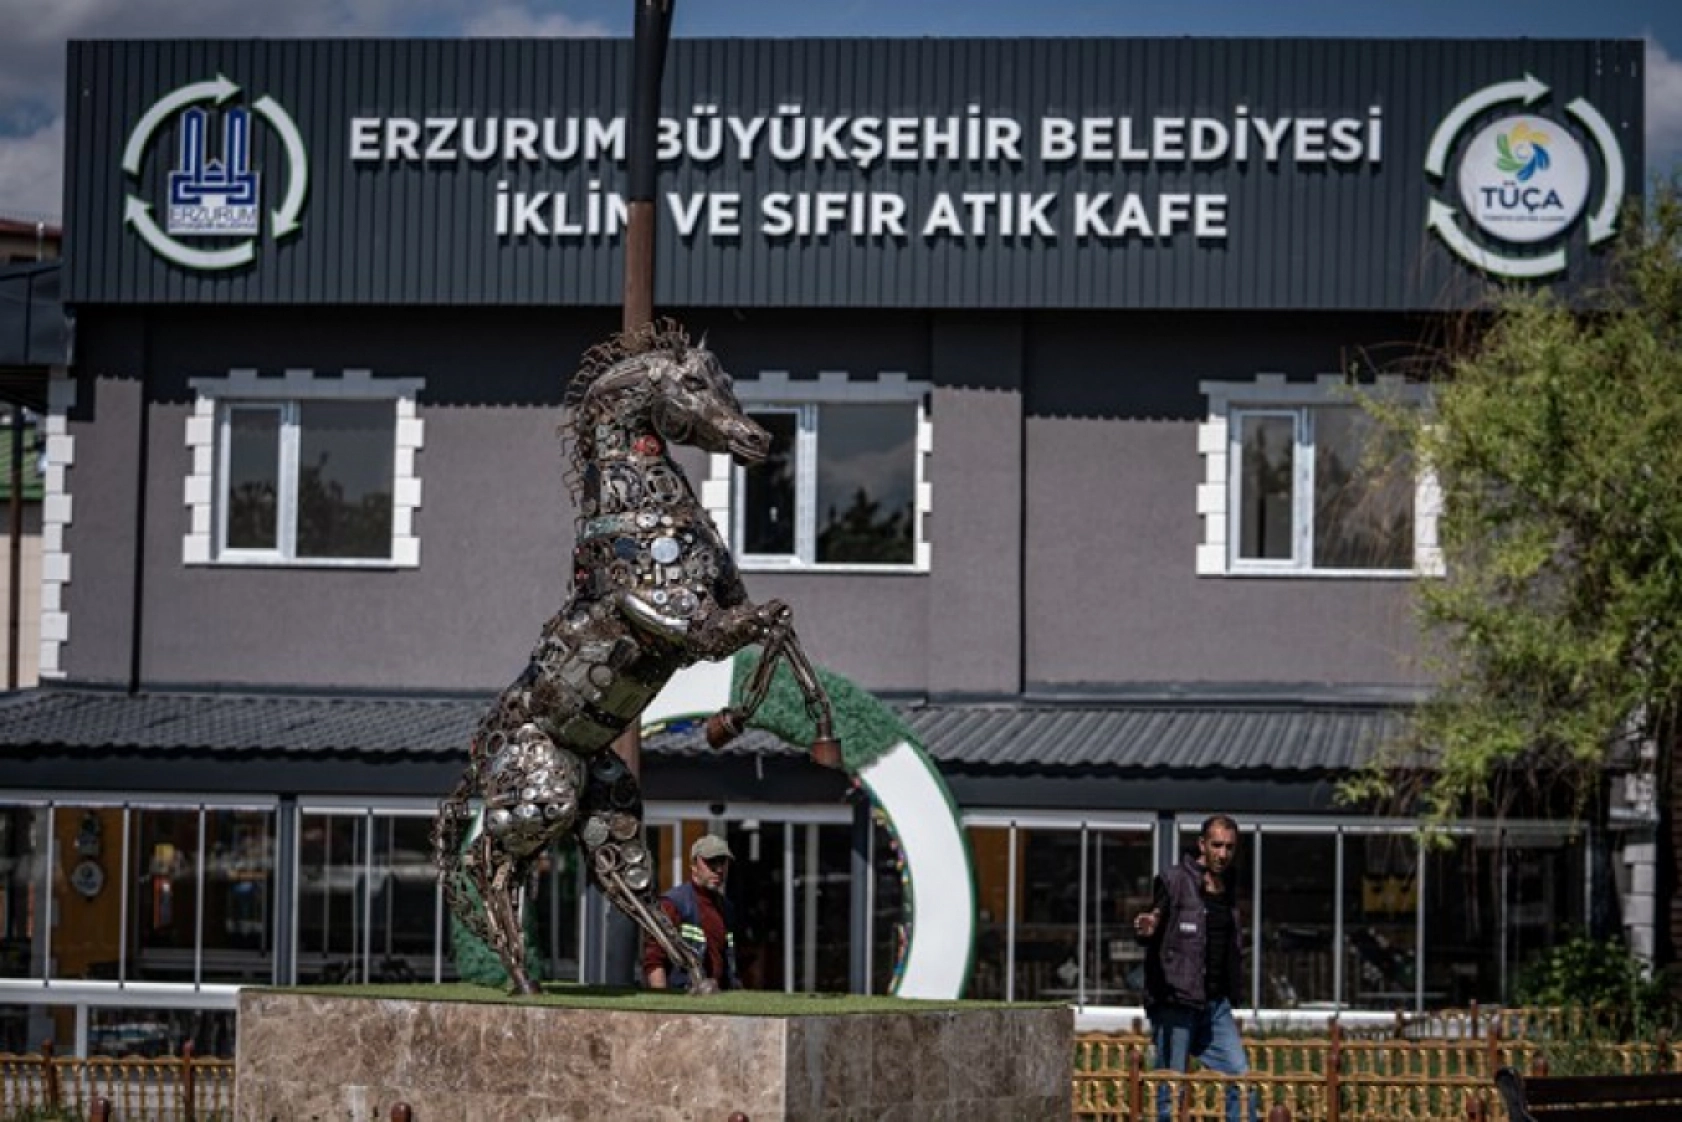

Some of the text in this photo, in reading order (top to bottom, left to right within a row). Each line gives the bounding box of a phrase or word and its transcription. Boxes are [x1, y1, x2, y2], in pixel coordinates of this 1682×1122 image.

[349, 103, 1383, 168] ERZURUM BÜYÜKŞEHİR BELEDİYESİ
[666, 191, 742, 236] VE
[760, 191, 907, 236] SIFIR
[922, 191, 1057, 237] ATIK
[1073, 191, 1228, 238] KAFE
[1480, 180, 1564, 214] TÜÇA
